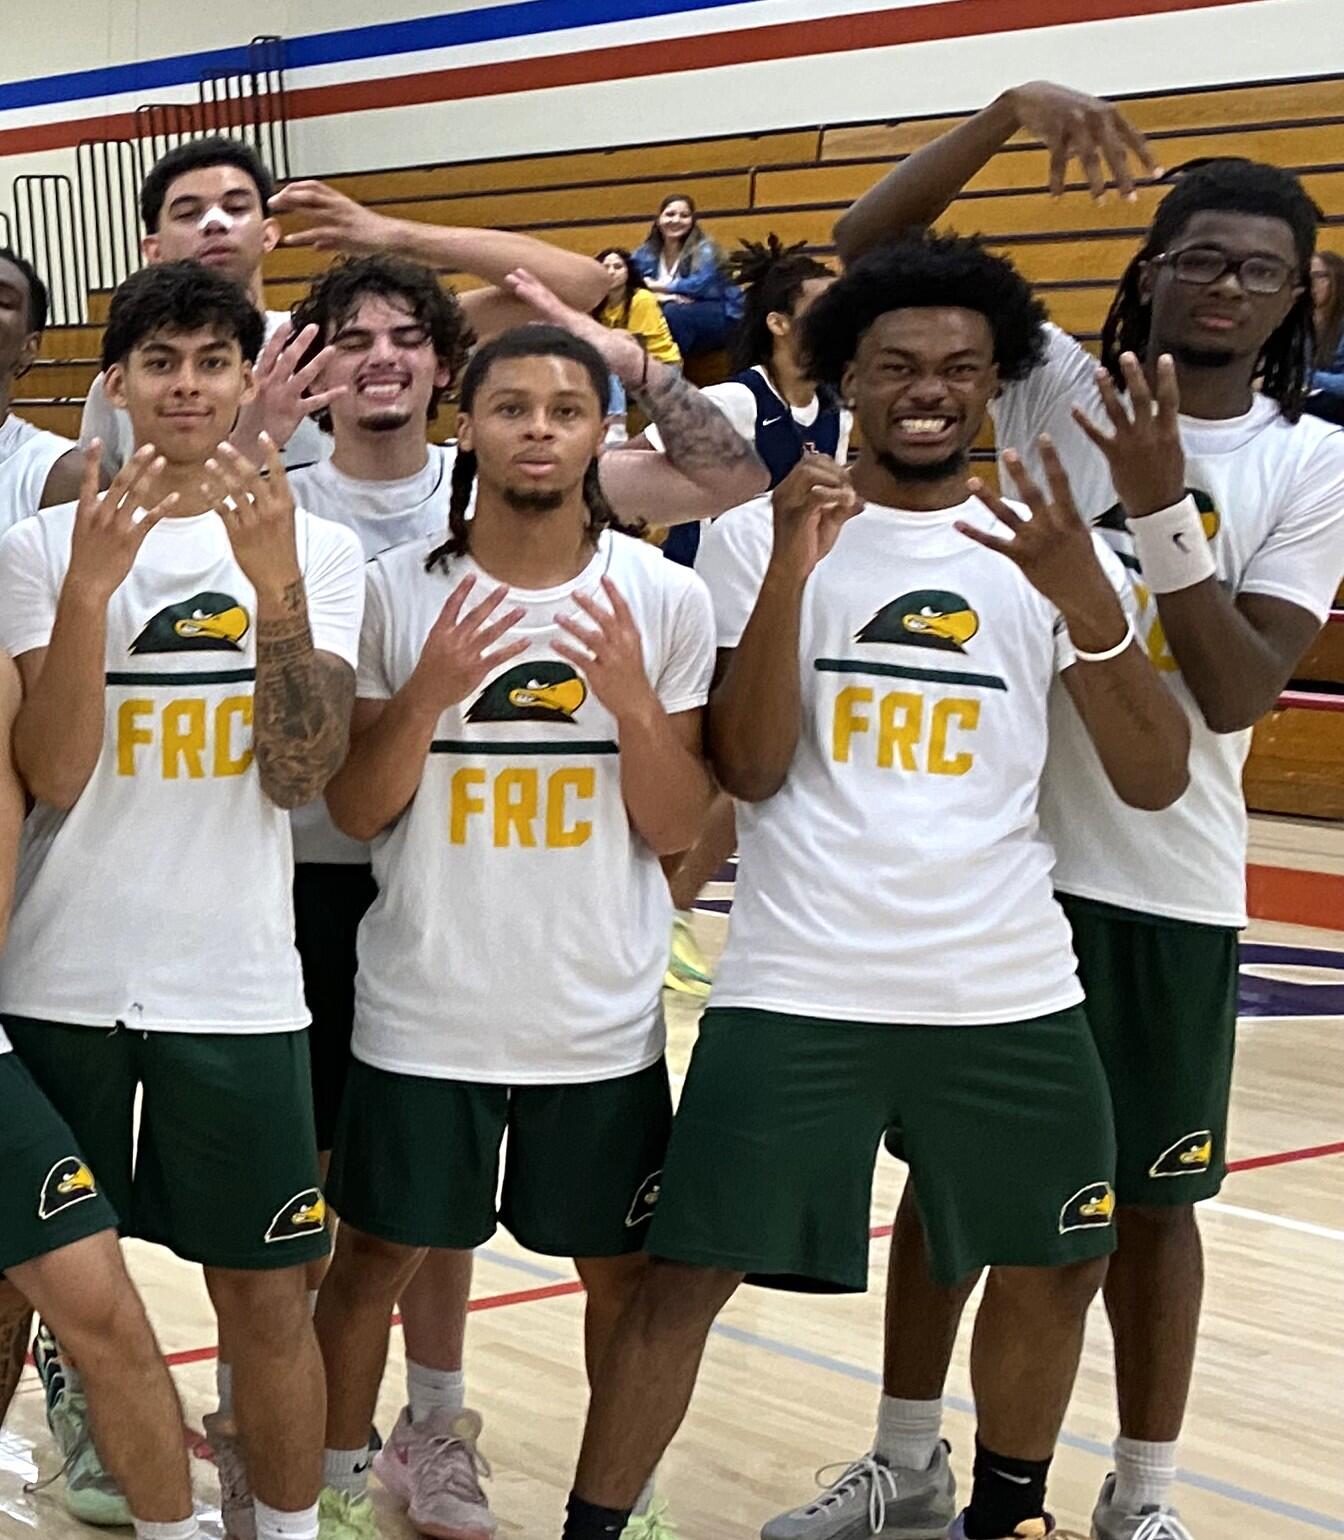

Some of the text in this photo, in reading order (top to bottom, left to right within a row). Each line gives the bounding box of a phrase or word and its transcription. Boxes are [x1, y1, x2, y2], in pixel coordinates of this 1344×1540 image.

[117, 696, 254, 779] FRC
[833, 686, 981, 776] FRC
[450, 767, 595, 848] FRC
